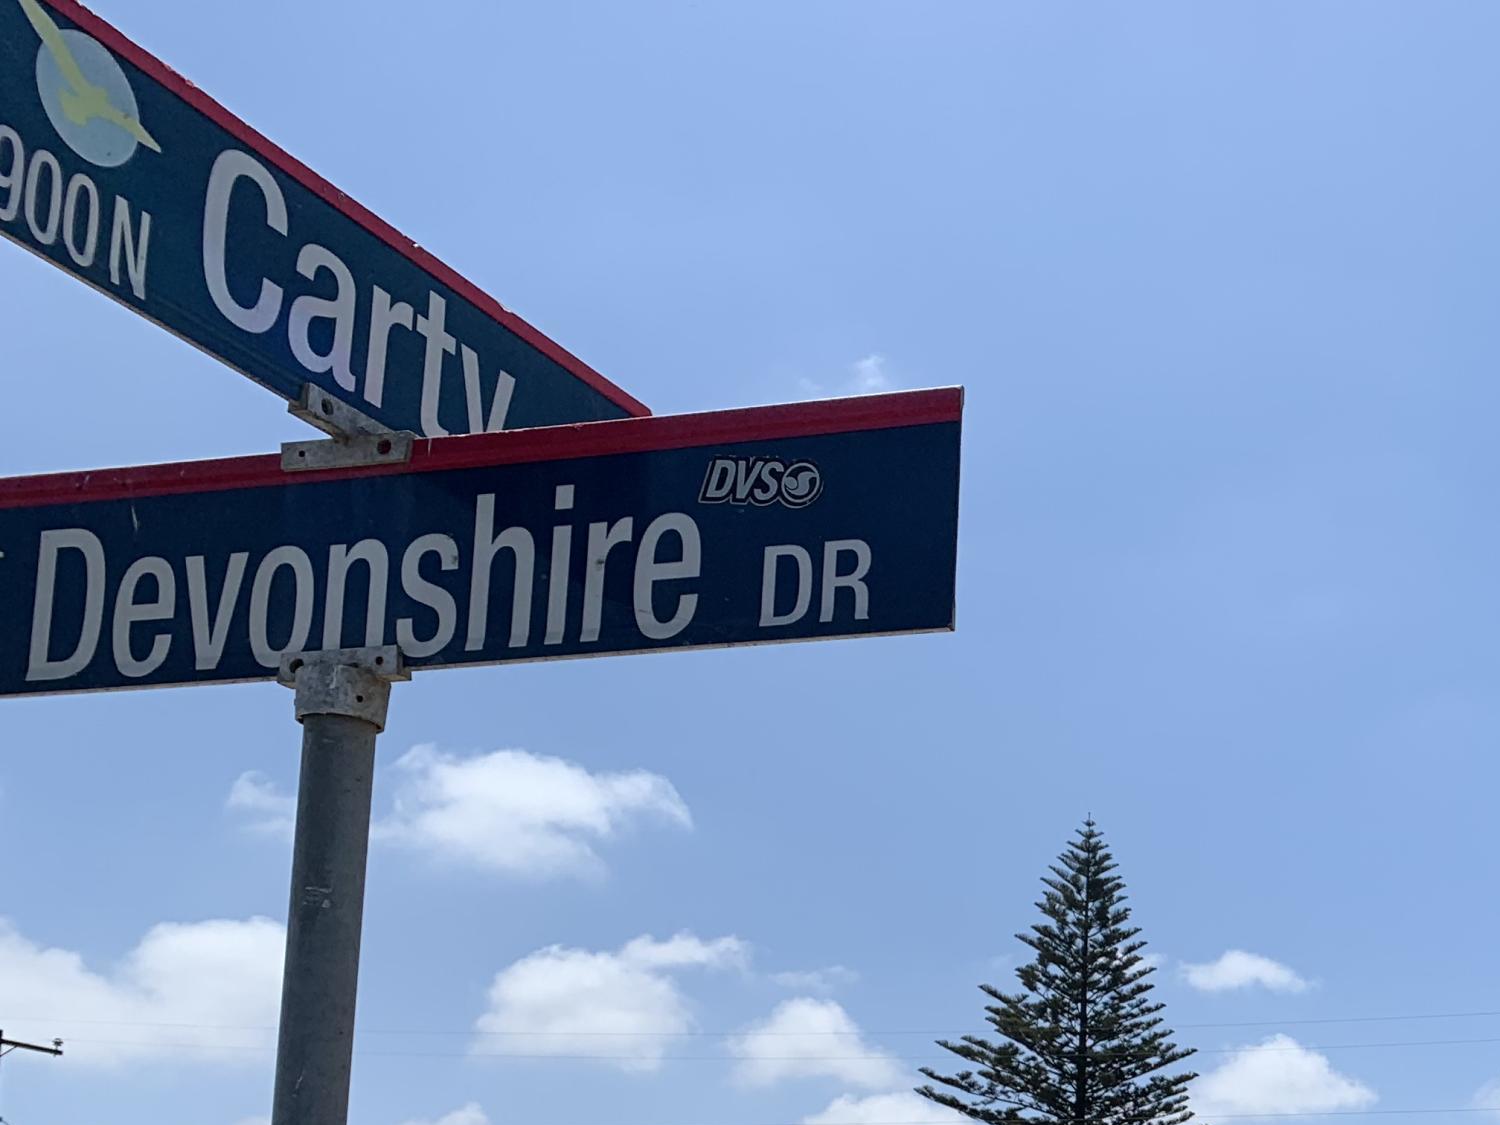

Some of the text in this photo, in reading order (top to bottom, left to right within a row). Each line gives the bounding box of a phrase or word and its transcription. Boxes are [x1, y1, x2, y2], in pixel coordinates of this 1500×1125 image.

[109, 194, 151, 300] N
[25, 484, 872, 681] Devonshire DR
